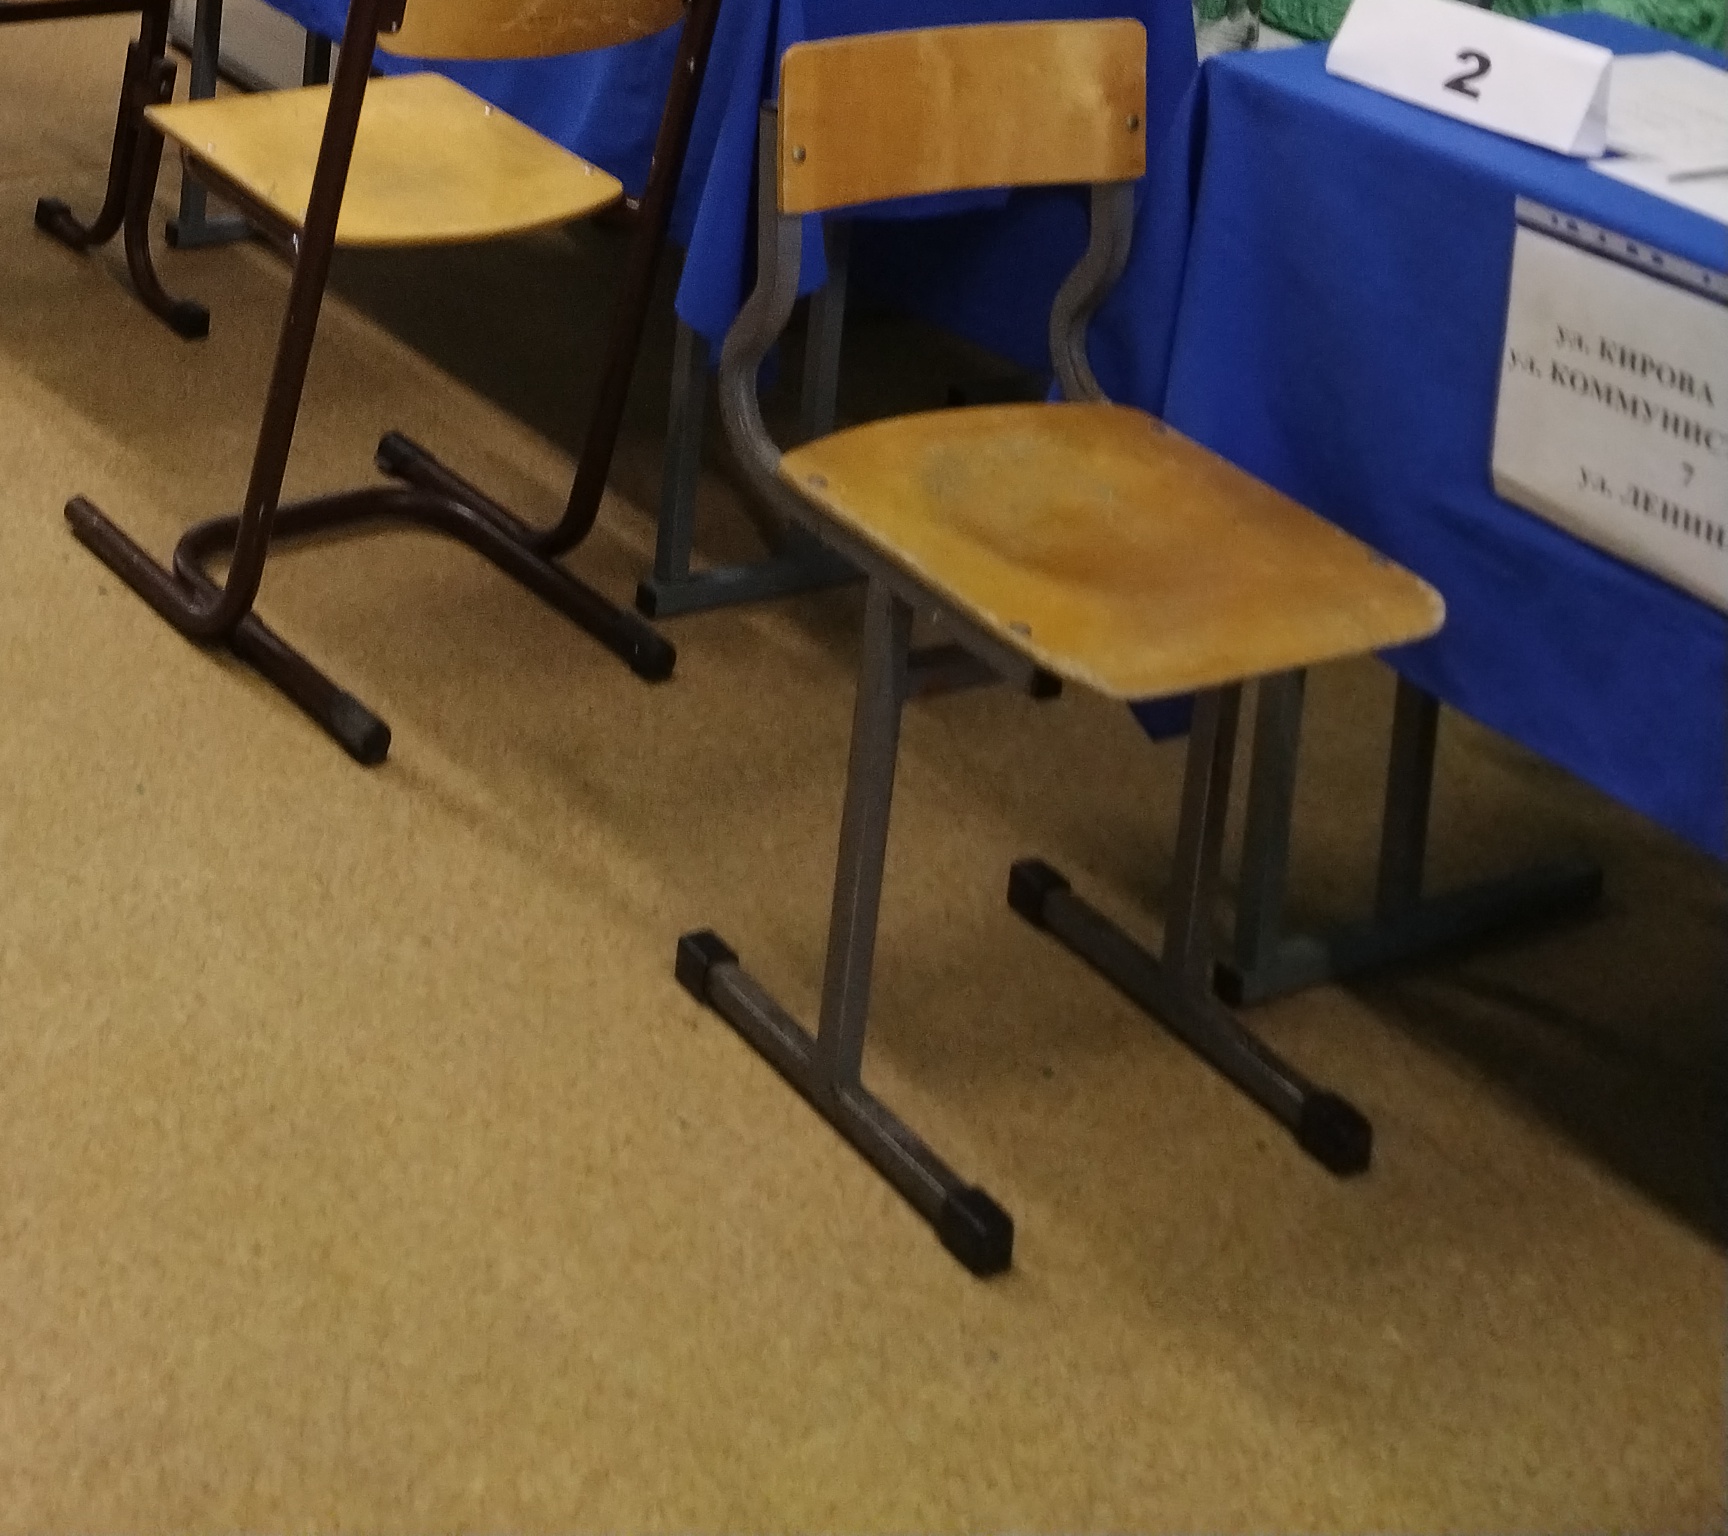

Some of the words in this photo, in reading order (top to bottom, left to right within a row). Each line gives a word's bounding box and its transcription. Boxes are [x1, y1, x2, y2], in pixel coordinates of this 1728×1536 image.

[1443, 49, 1491, 102] 2
[1509, 348, 1541, 378] ул.
[1556, 324, 1589, 355] ул.
[1599, 335, 1715, 407] КИРОВА
[1578, 464, 1612, 499] ул.
